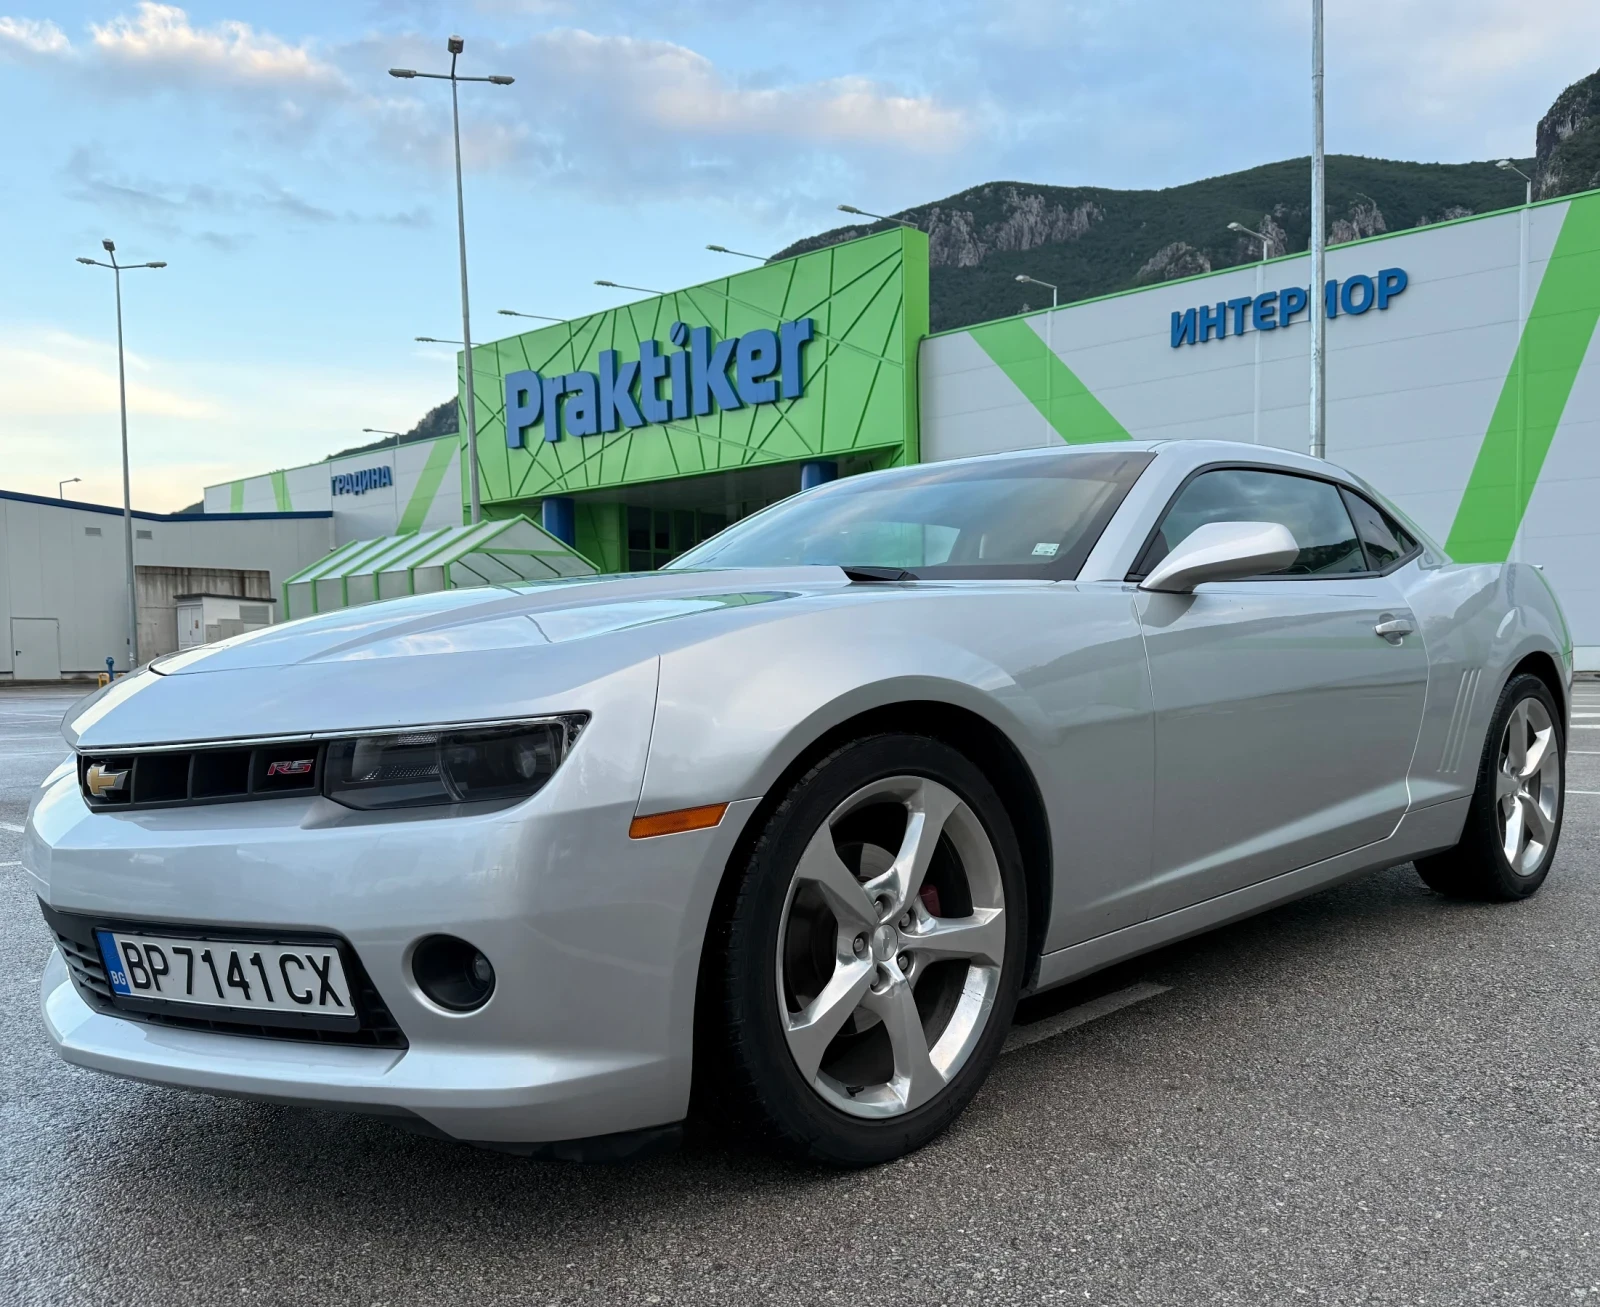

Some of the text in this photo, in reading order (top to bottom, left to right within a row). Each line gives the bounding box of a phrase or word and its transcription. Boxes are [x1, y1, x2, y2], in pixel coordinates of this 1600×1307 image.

[505, 318, 814, 448] Praktiker
[331, 466, 393, 496] ГРАДИНА
[267, 759, 314, 776] RS
[110, 970, 127, 985] BG
